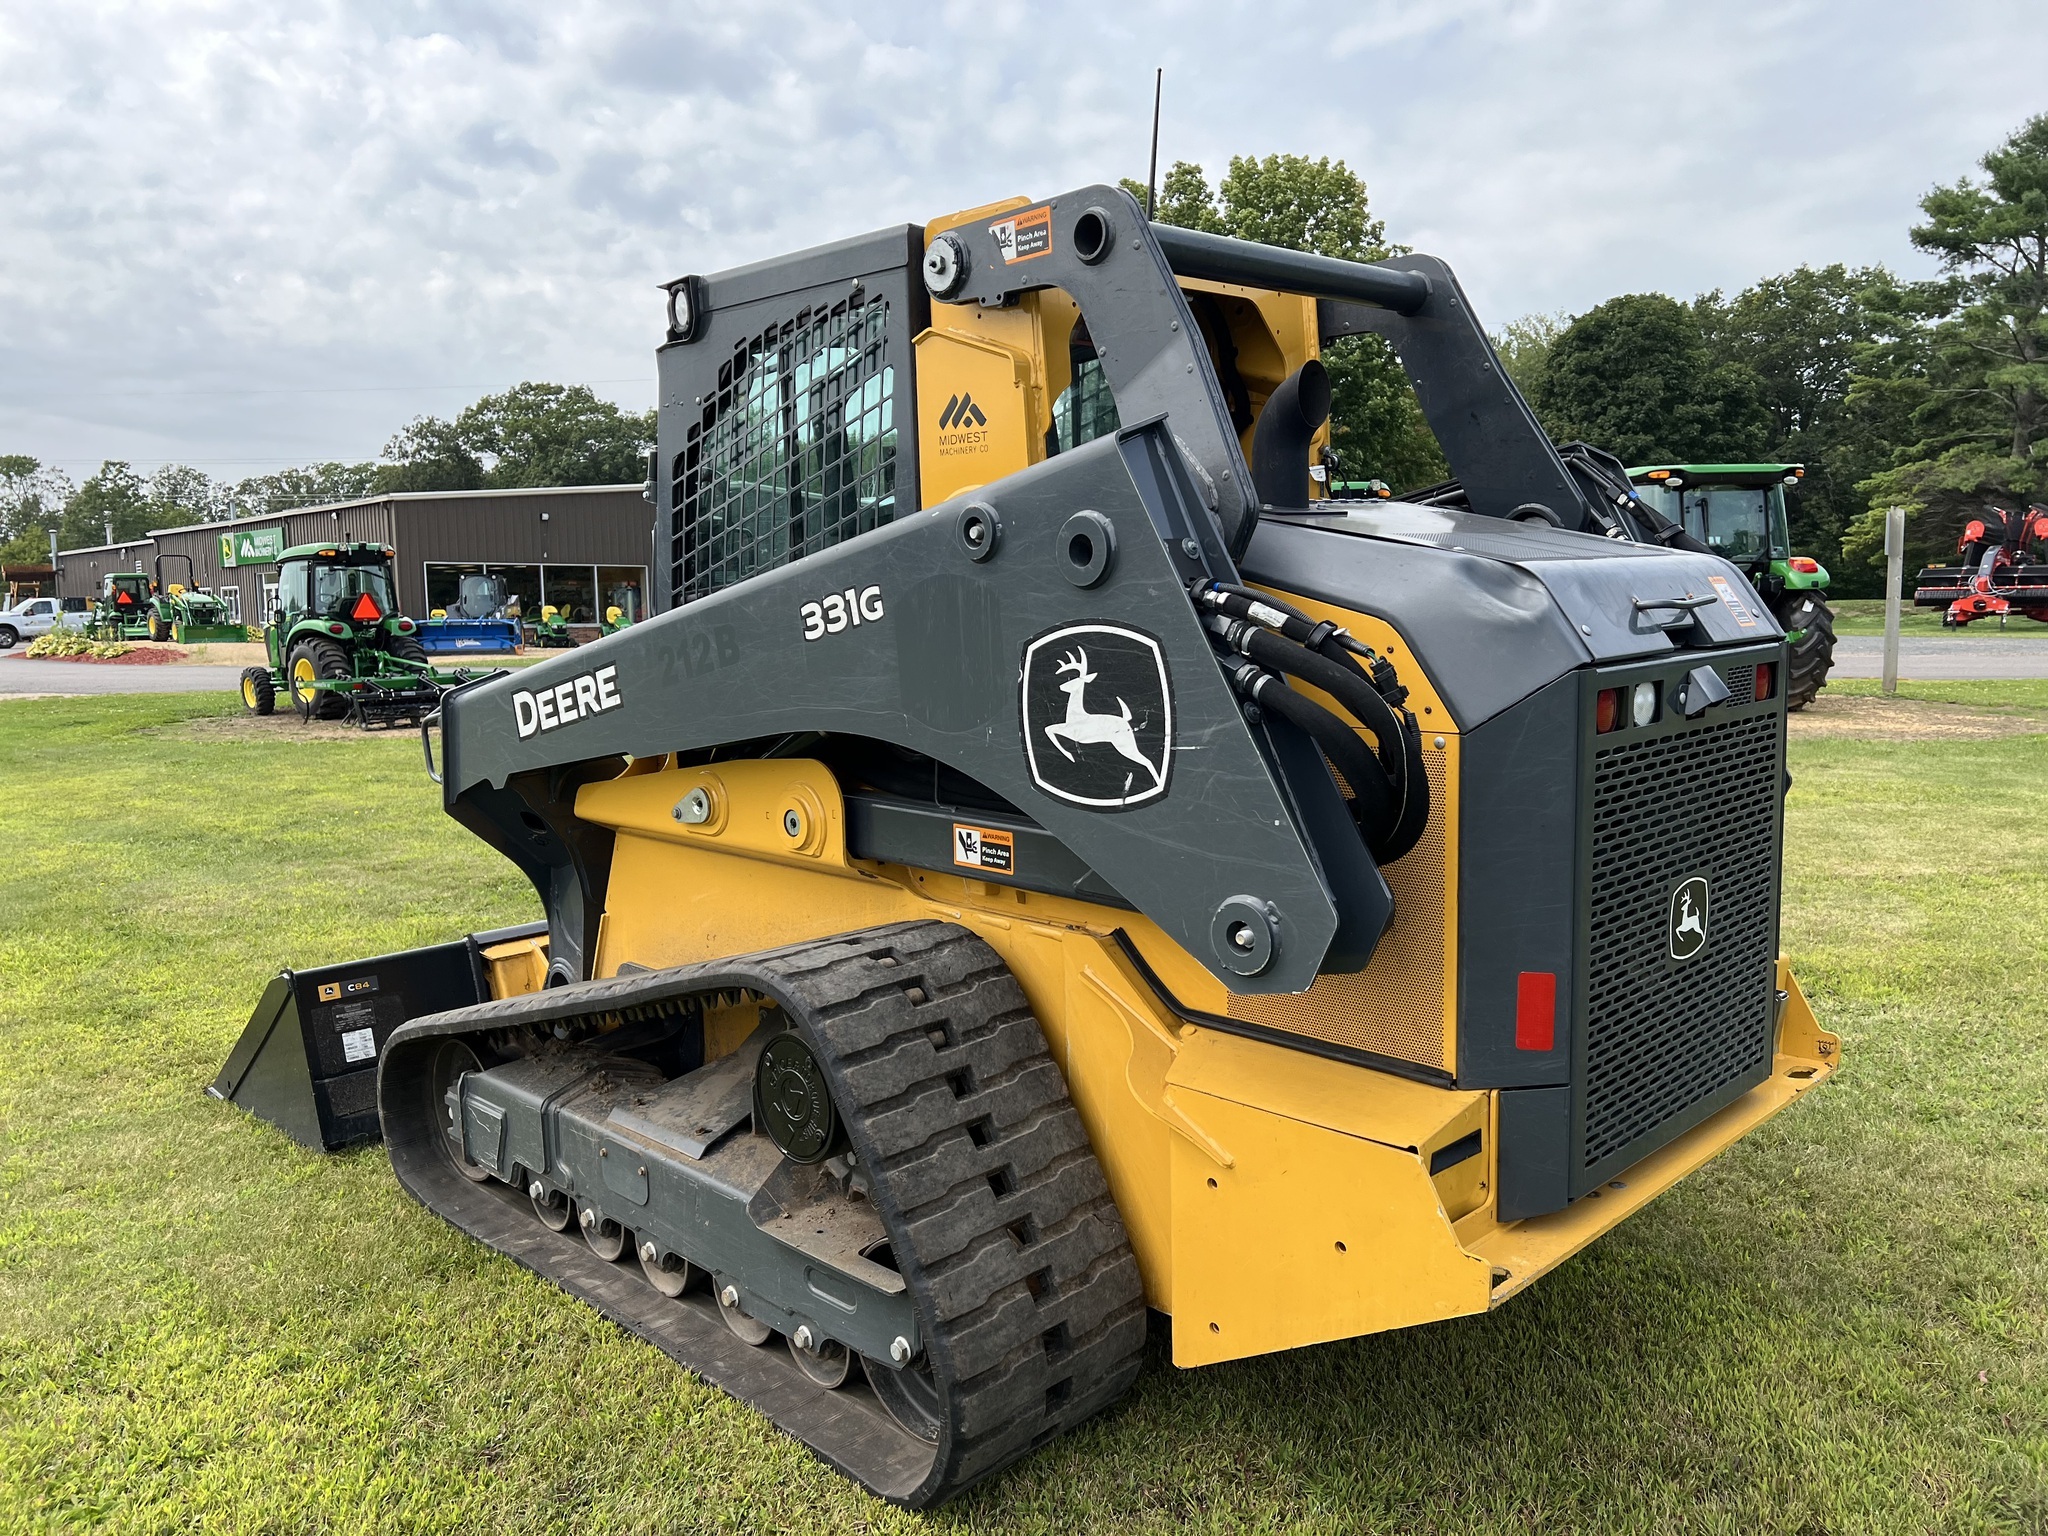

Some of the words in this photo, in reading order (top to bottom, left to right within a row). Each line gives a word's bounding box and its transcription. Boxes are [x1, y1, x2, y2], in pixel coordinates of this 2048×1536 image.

[1022, 211, 1047, 224] WARNING
[1017, 231, 1033, 243] Pinch
[1034, 229, 1047, 238] Area
[1017, 243, 1030, 252] Keep
[1030, 240, 1043, 249] Away
[939, 431, 988, 446] MIDWEST
[940, 446, 977, 456] MACHINERY
[980, 445, 989, 453] CO
[254, 534, 276, 546] MIDWEST
[800, 585, 885, 641] 331G
[513, 663, 621, 738] DEERE
[987, 833, 1010, 843] WARNING
[982, 846, 996, 855] Pinch
[997, 849, 1010, 858] Area
[994, 858, 1006, 866] Away
[347, 981, 370, 992] C84
